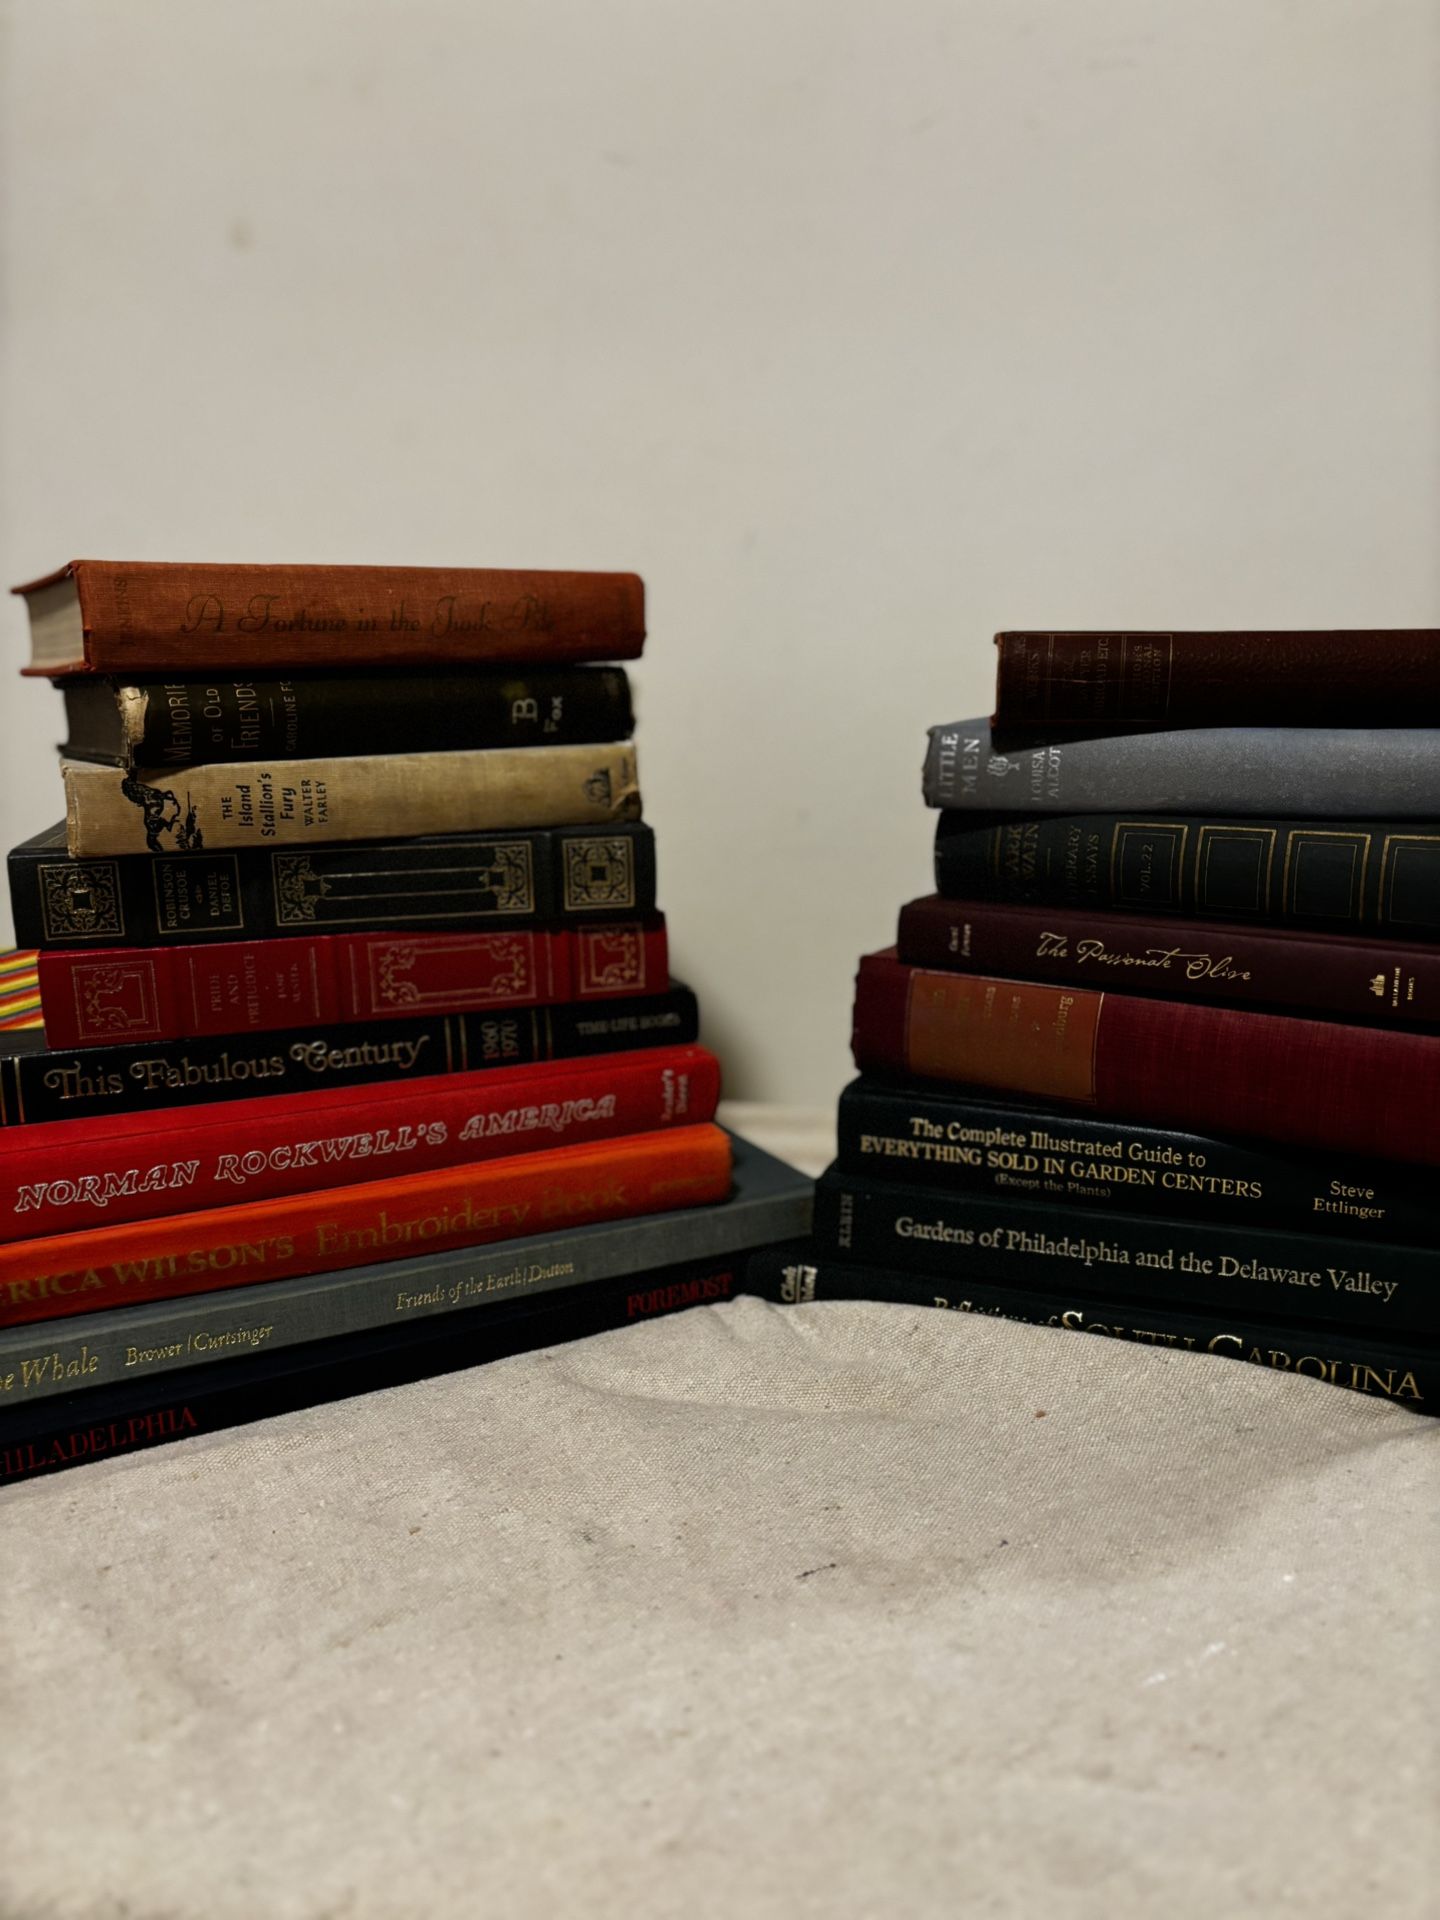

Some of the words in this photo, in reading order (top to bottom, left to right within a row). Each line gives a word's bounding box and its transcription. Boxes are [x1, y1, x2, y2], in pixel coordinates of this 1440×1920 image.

[181, 594, 225, 633] A
[238, 594, 346, 633] Fortune
[357, 607, 378, 632] in
[390, 601, 421, 632] the
[430, 595, 491, 639] Junk
[282, 695, 298, 751] CAROLINE
[511, 697, 538, 725] B
[940, 733, 958, 799] LITTLE
[961, 738, 980, 794] MEN
[1031, 749, 1046, 801] LOUISA
[221, 796, 233, 820] THE
[236, 784, 254, 827] Island
[257, 773, 276, 836] Stallion's
[280, 787, 297, 820] Fury
[301, 779, 314, 827] WALTER
[315, 780, 329, 823] FARLEY
[1022, 823, 1040, 887] WAIN
[1064, 824, 1082, 897] ERARY
[162, 863, 178, 929] ROBINSON
[176, 869, 191, 920] CRUSOE
[208, 871, 221, 918] DANIEL
[220, 871, 233, 913] DEFOE
[1035, 931, 1069, 958] The
[1076, 938, 1208, 970] Passionate
[1186, 956, 1252, 982] Olive
[209, 974, 222, 1012] PRIDE
[226, 973, 241, 1005] AND
[243, 951, 260, 1025] PREJUDICE
[43, 1060, 125, 1100] This
[130, 1053, 286, 1092] Fabulous
[289, 1034, 431, 1073] Century
[13, 1160, 201, 1213] NORMAN
[214, 1120, 449, 1185] ROCKWELL'S
[458, 1092, 617, 1142] AMERICA
[859, 1134, 983, 1167] EVERYTHING
[987, 1151, 1039, 1173] SOLD
[1043, 1157, 1066, 1176] IN
[1070, 1160, 1157, 1187] GARDEN
[1161, 1172, 1263, 1200] CENTERS
[909, 1115, 944, 1140] The
[946, 1120, 1027, 1150] Complete
[1029, 1130, 1123, 1161] Illustrated
[1127, 1142, 1183, 1167] Guide
[1186, 1151, 1207, 1169] to
[994, 1172, 1041, 1192] (Except
[1044, 1178, 1065, 1192] the
[1067, 1180, 1112, 1199] Plants)
[1311, 1197, 1387, 1220] Ettlinger
[1329, 1179, 1376, 1200] Steve
[0, 1266, 108, 1308] RICA
[112, 1233, 297, 1286] WILSON'S
[315, 1197, 532, 1257] Embroidery
[542, 1178, 630, 1219] Book
[894, 1215, 975, 1246] Gardens
[978, 1227, 1003, 1249] of
[1004, 1229, 1131, 1267] Philadelphia
[1134, 1248, 1175, 1271] and
[1178, 1251, 1215, 1275] the
[1217, 1255, 1322, 1288] Delaware
[1326, 1267, 1400, 1303] Valley
[626, 1269, 735, 1320] FOREMOST
[20, 1345, 99, 1389] Whale
[395, 1283, 446, 1312] Friends
[448, 1280, 464, 1305] of
[465, 1276, 484, 1296] the
